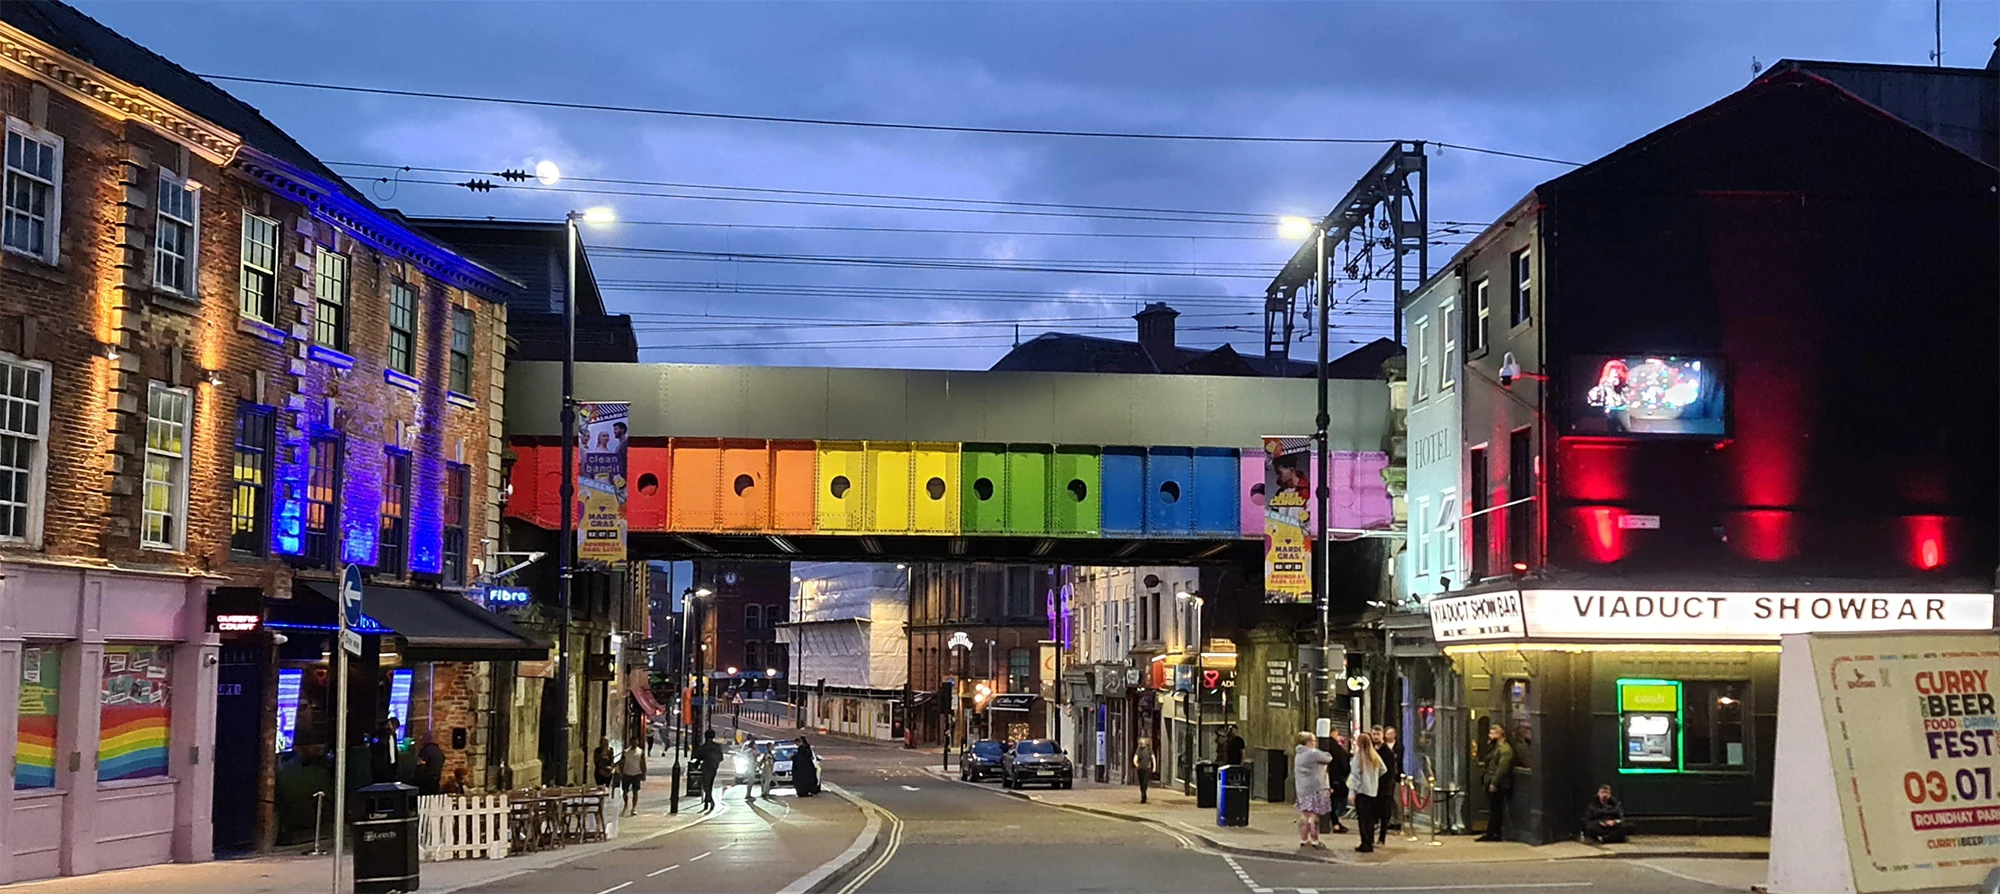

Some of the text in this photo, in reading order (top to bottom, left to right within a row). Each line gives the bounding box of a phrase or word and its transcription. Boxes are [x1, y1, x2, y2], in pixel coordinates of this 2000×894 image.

[1415, 428, 1452, 470] HOTEL
[586, 465, 620, 473] bandit
[588, 455, 618, 464] clean
[489, 589, 527, 602] Fibre
[1432, 600, 1469, 624] VIADUCT
[1572, 594, 1947, 621] VIADUCT SHOWBAR
[1915, 669, 1989, 695] CURRY
[1927, 693, 1996, 718] BEER
[1924, 718, 1957, 731] FOOD
[1925, 729, 1994, 760] FEST
[1915, 811, 1973, 827] ROUNDHAY
[374, 831, 397, 839] Leeds
